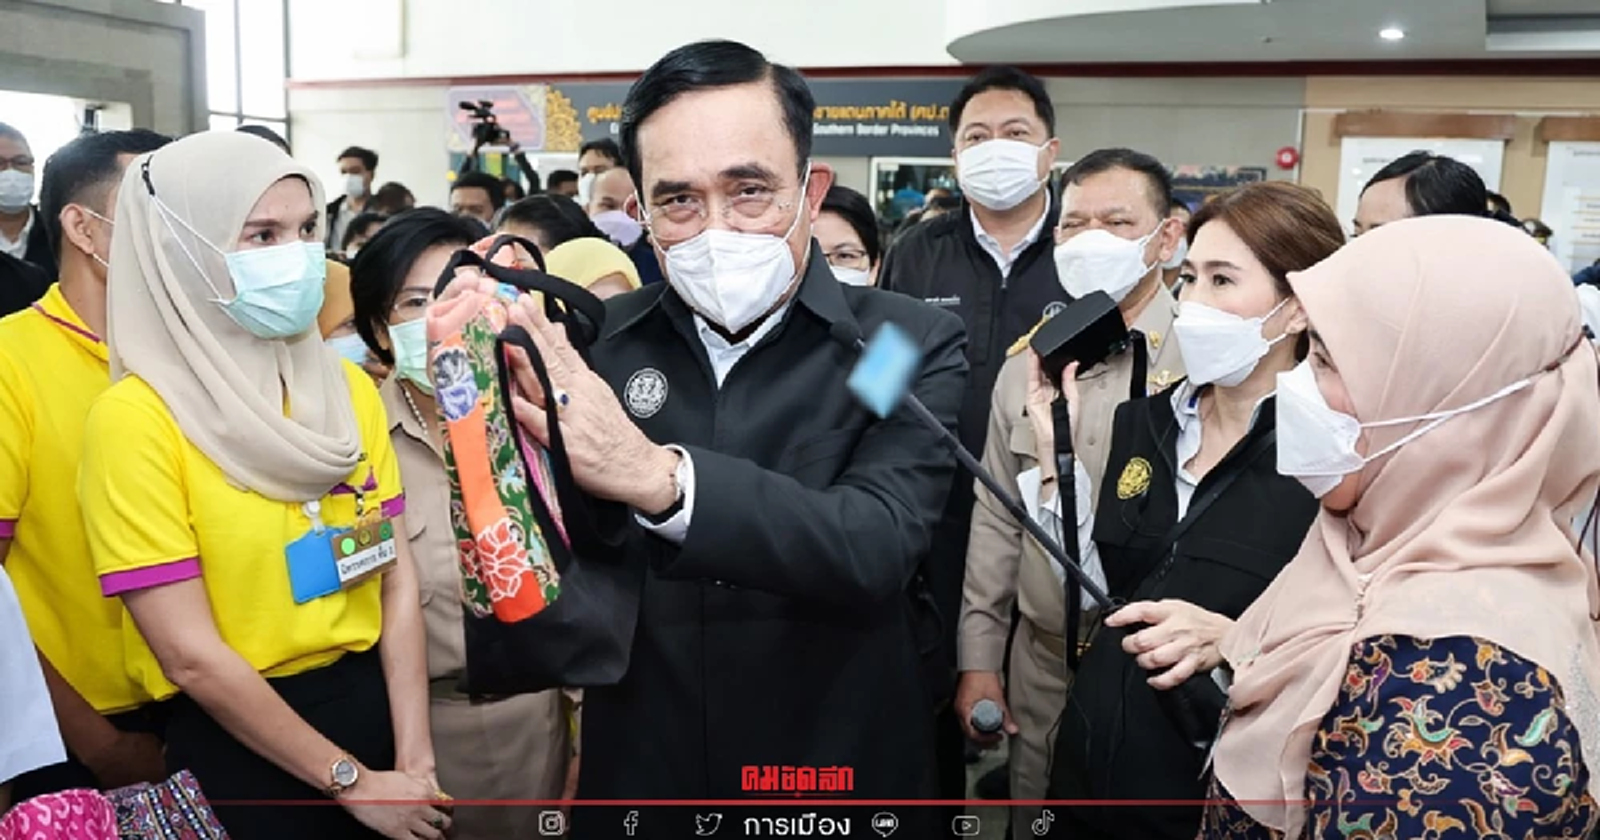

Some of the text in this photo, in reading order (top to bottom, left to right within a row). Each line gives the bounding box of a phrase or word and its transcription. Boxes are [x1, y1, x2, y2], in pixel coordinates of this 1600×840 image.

[812, 122, 939, 136] Southern Border Provinces
